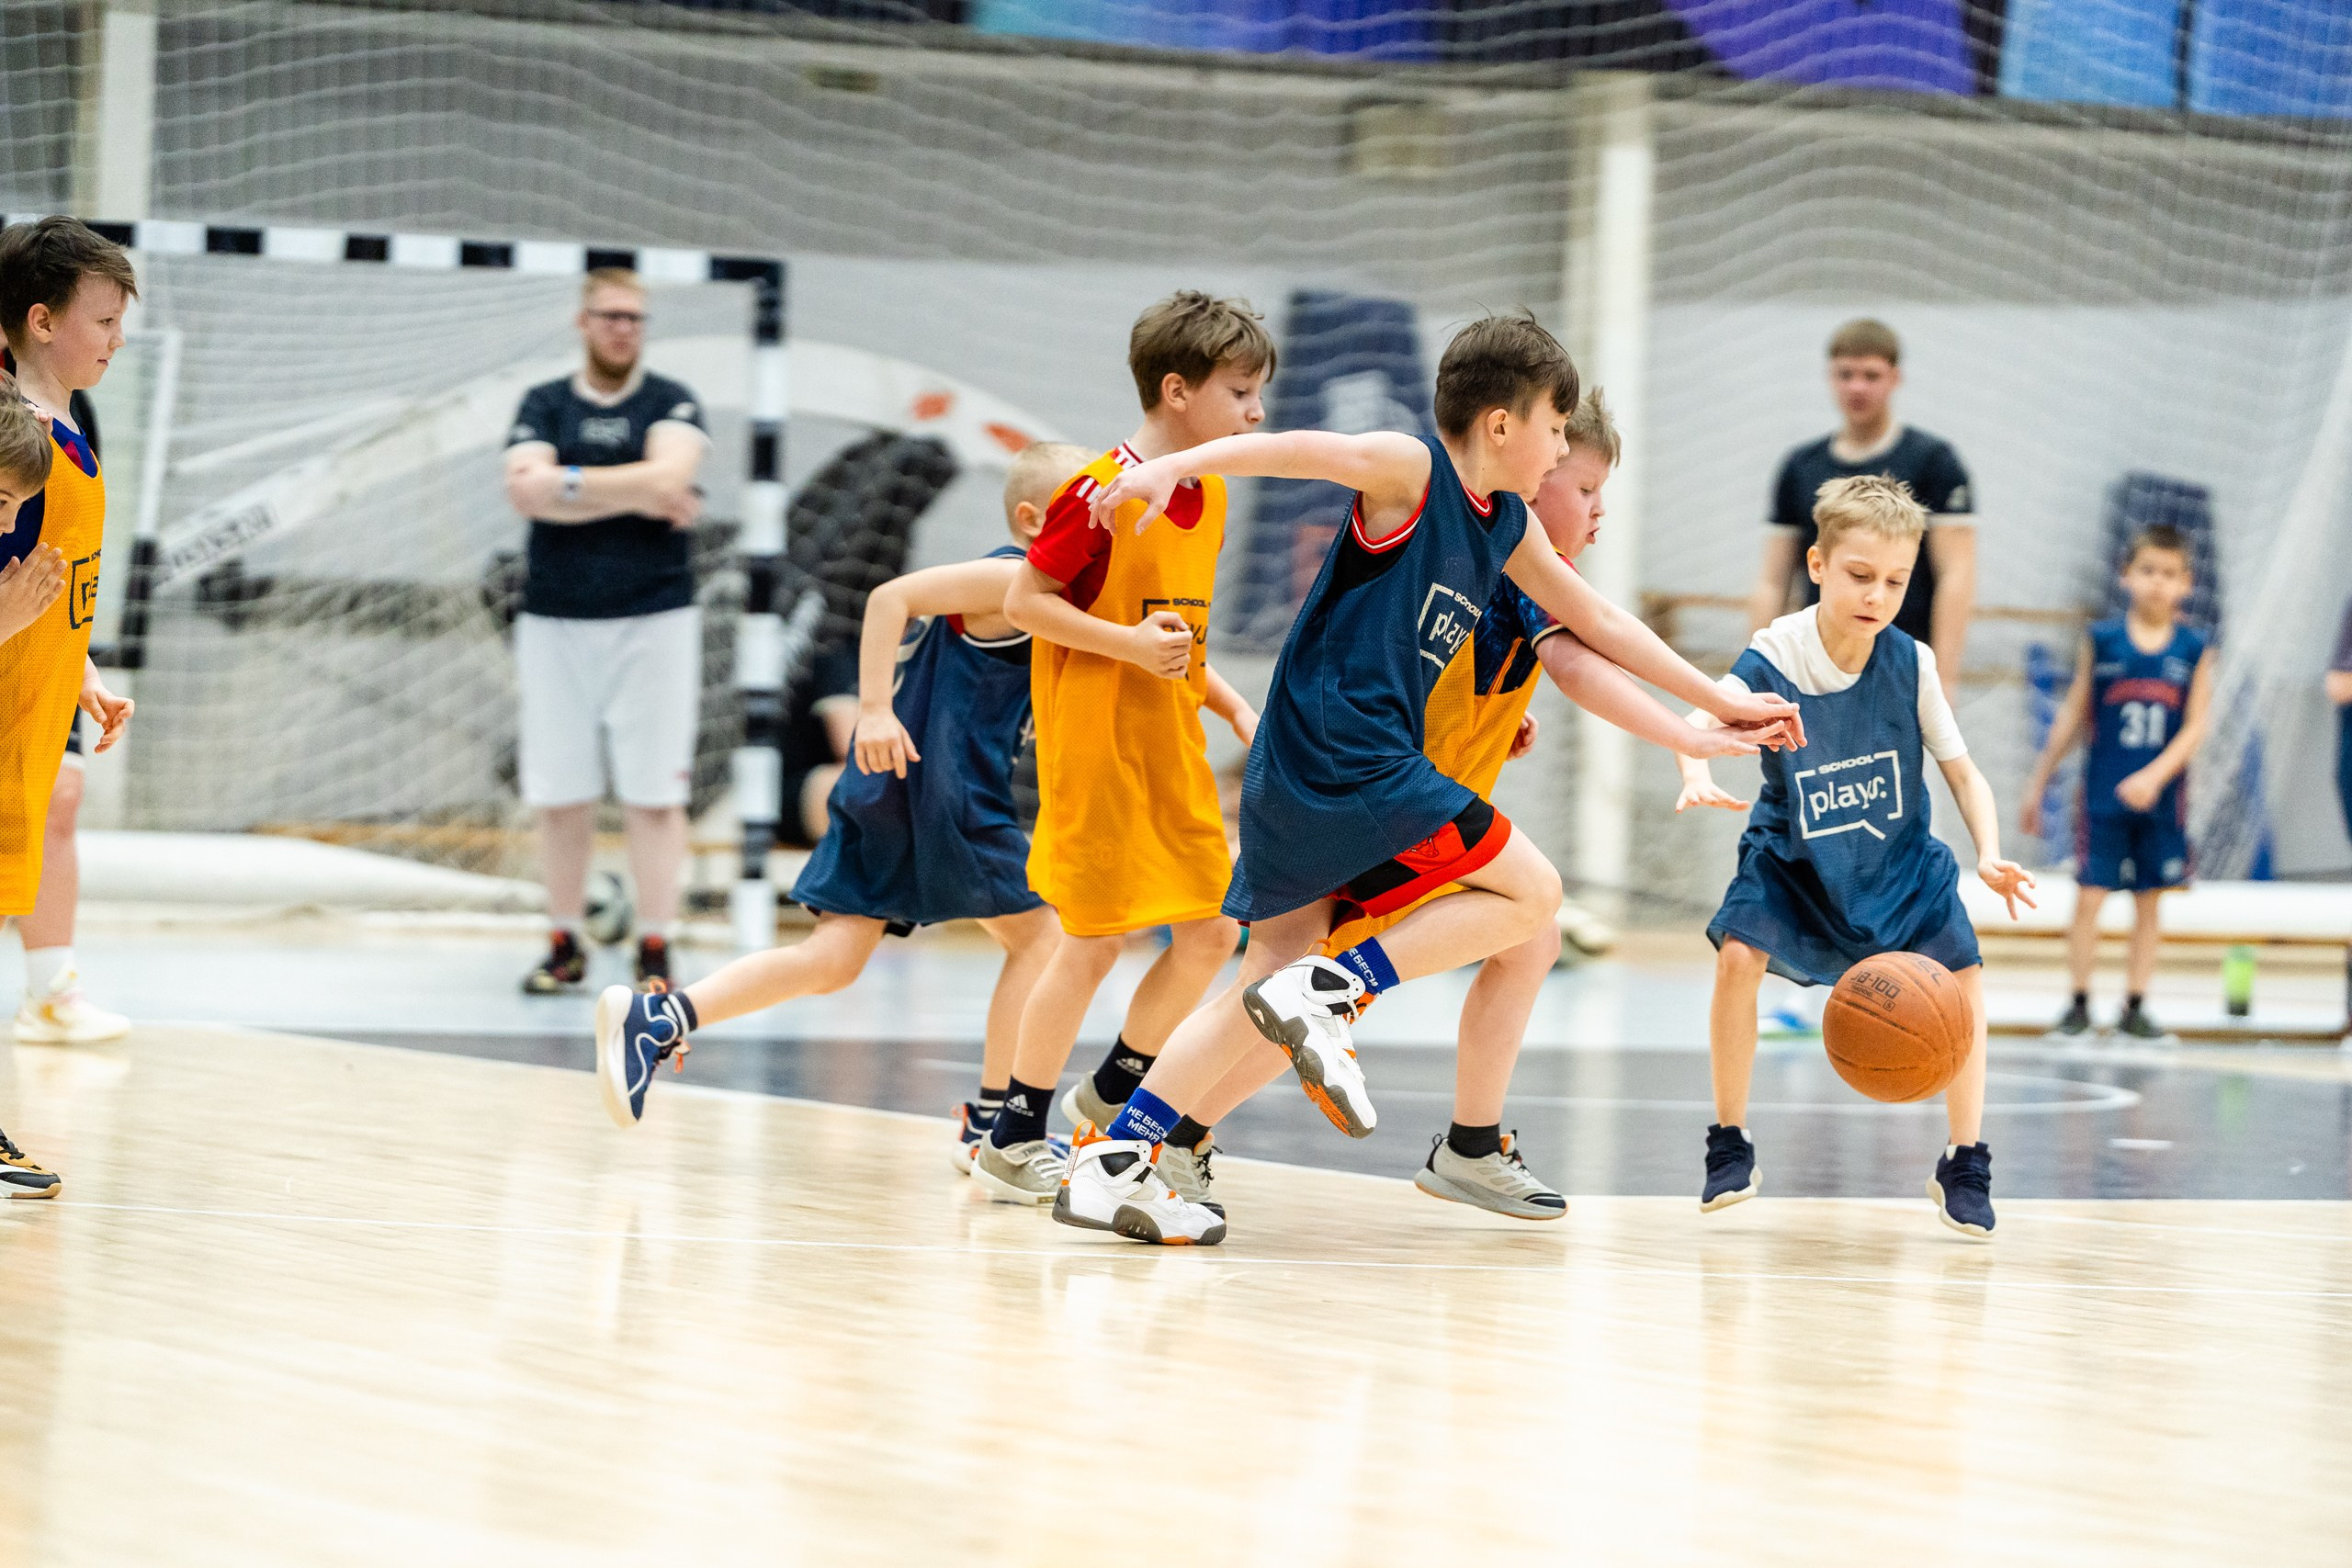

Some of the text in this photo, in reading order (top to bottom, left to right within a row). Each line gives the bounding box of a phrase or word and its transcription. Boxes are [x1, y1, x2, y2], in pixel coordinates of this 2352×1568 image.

[2119, 701, 2165, 749] 31
[1818, 755, 1875, 774] SCHOOL
[1850, 970, 1901, 999] JB-100
[1127, 1105, 1145, 1121] НЕ
[1127, 1118, 1160, 1143] МЕНЯ
